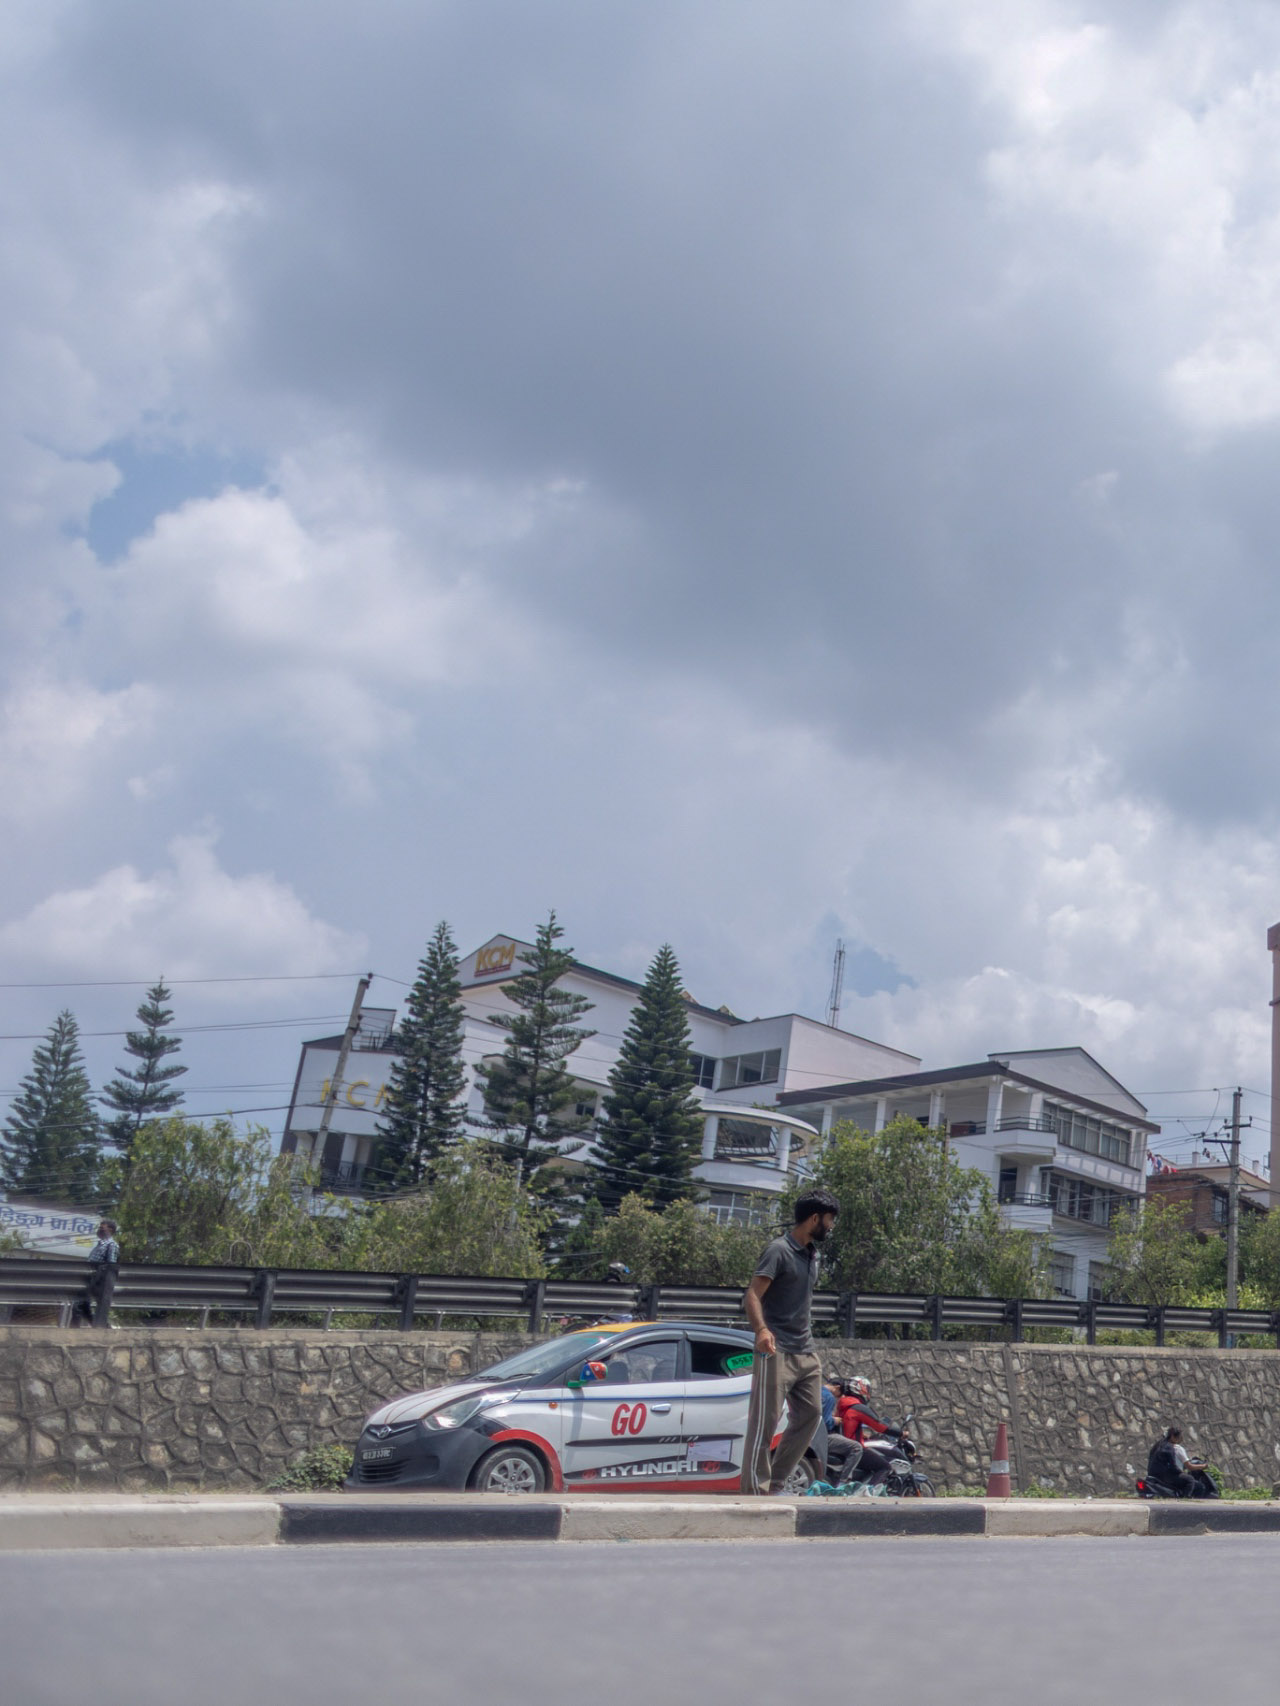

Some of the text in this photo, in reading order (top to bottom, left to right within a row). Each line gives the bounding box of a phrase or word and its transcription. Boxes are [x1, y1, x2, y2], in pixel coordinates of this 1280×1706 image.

[475, 943, 516, 971] KCM
[611, 1402, 648, 1436] GO
[601, 1460, 699, 1478] HYUNDAI
